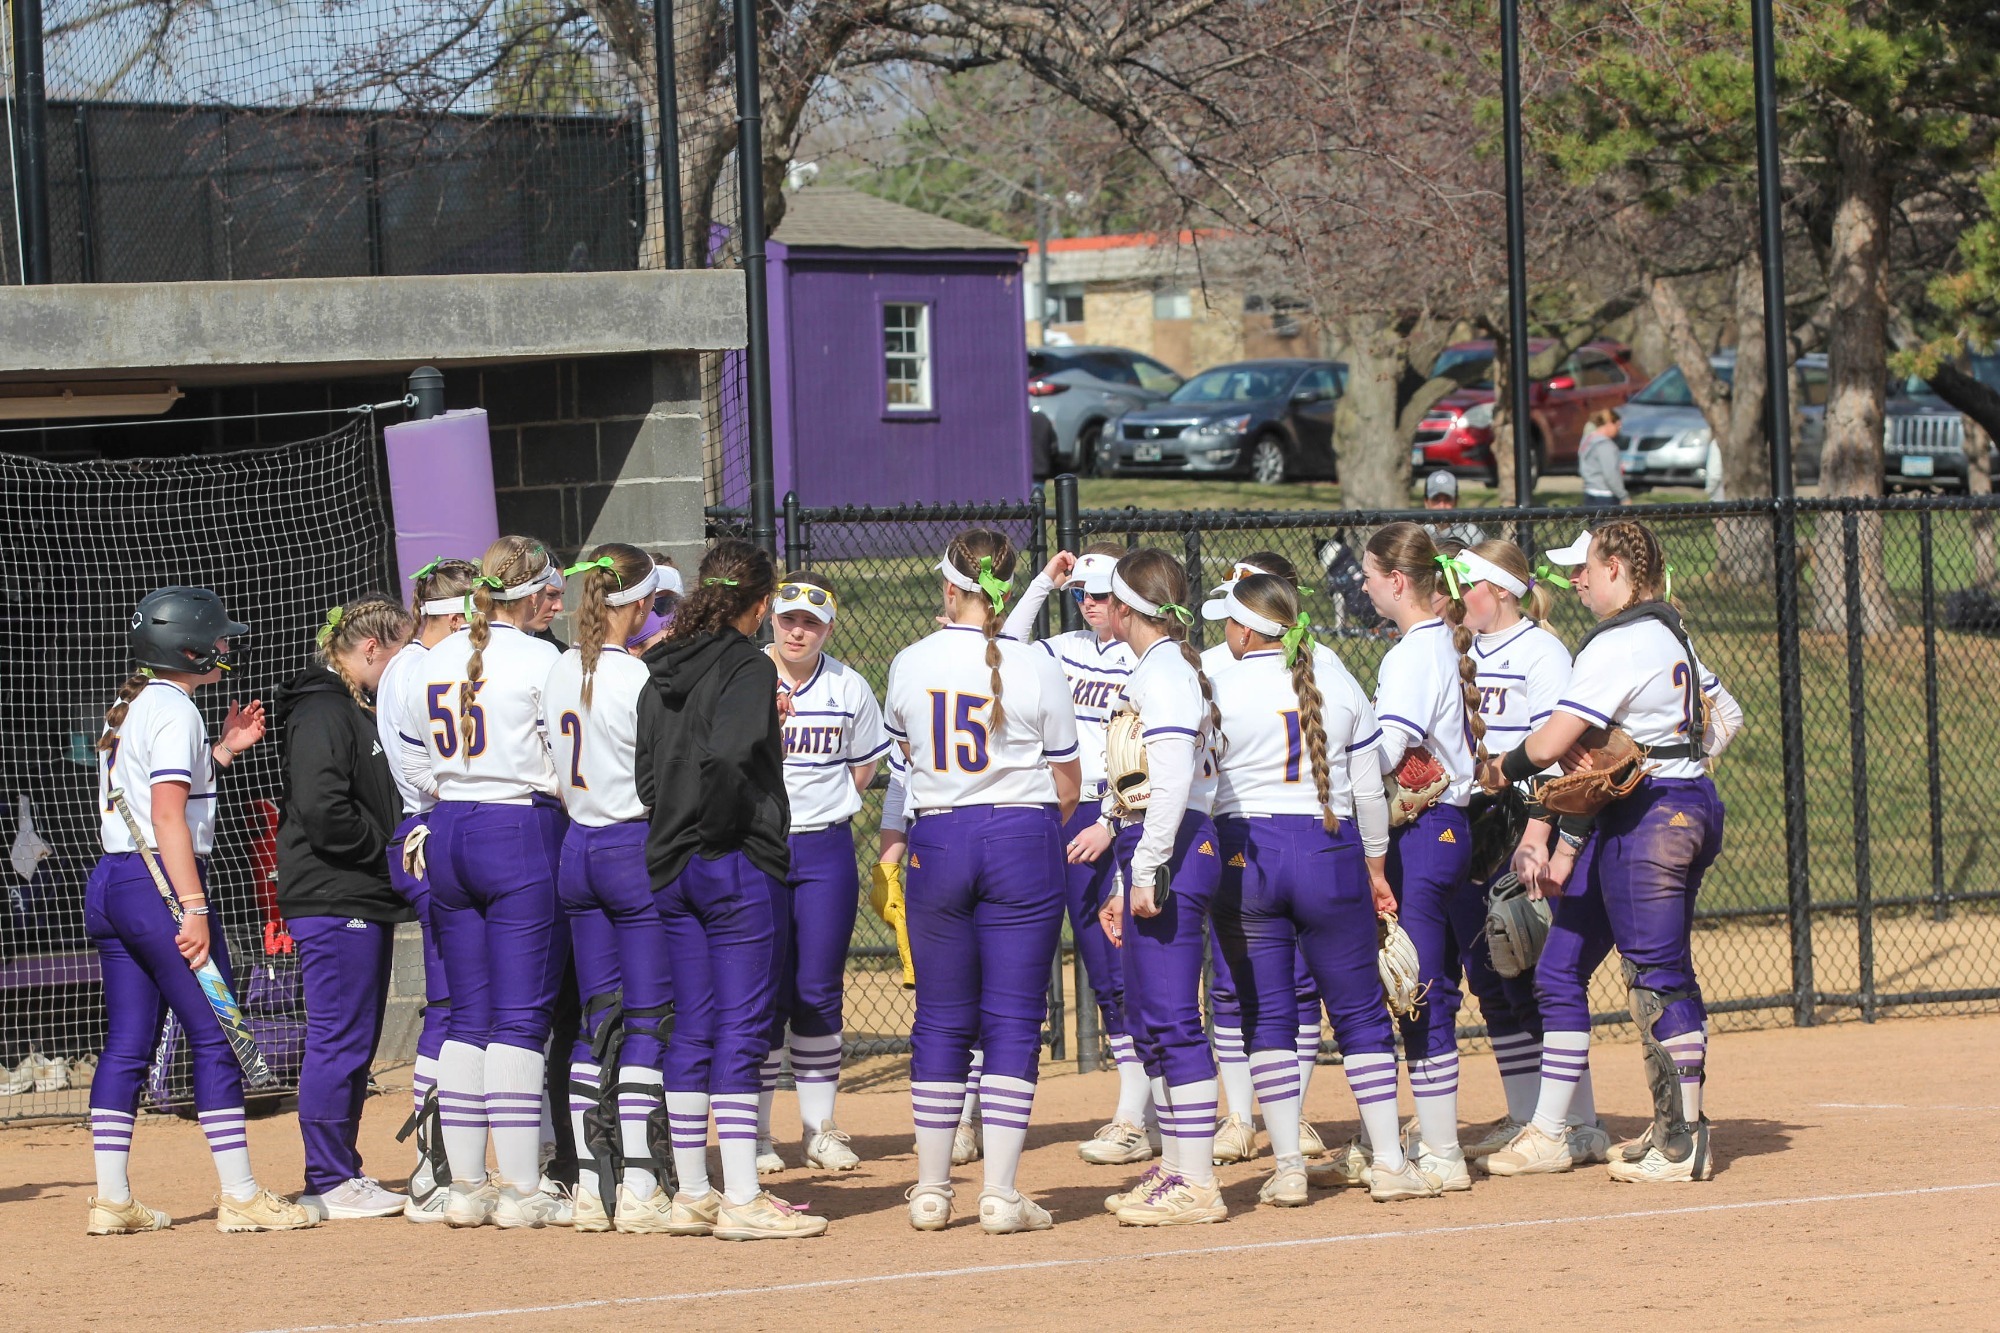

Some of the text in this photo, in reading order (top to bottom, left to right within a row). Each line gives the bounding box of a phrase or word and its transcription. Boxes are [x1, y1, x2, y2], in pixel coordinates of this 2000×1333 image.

[425, 677, 488, 761] 55
[560, 708, 590, 792] 2
[926, 689, 993, 774] 15
[1127, 792, 1152, 804] Wilso
